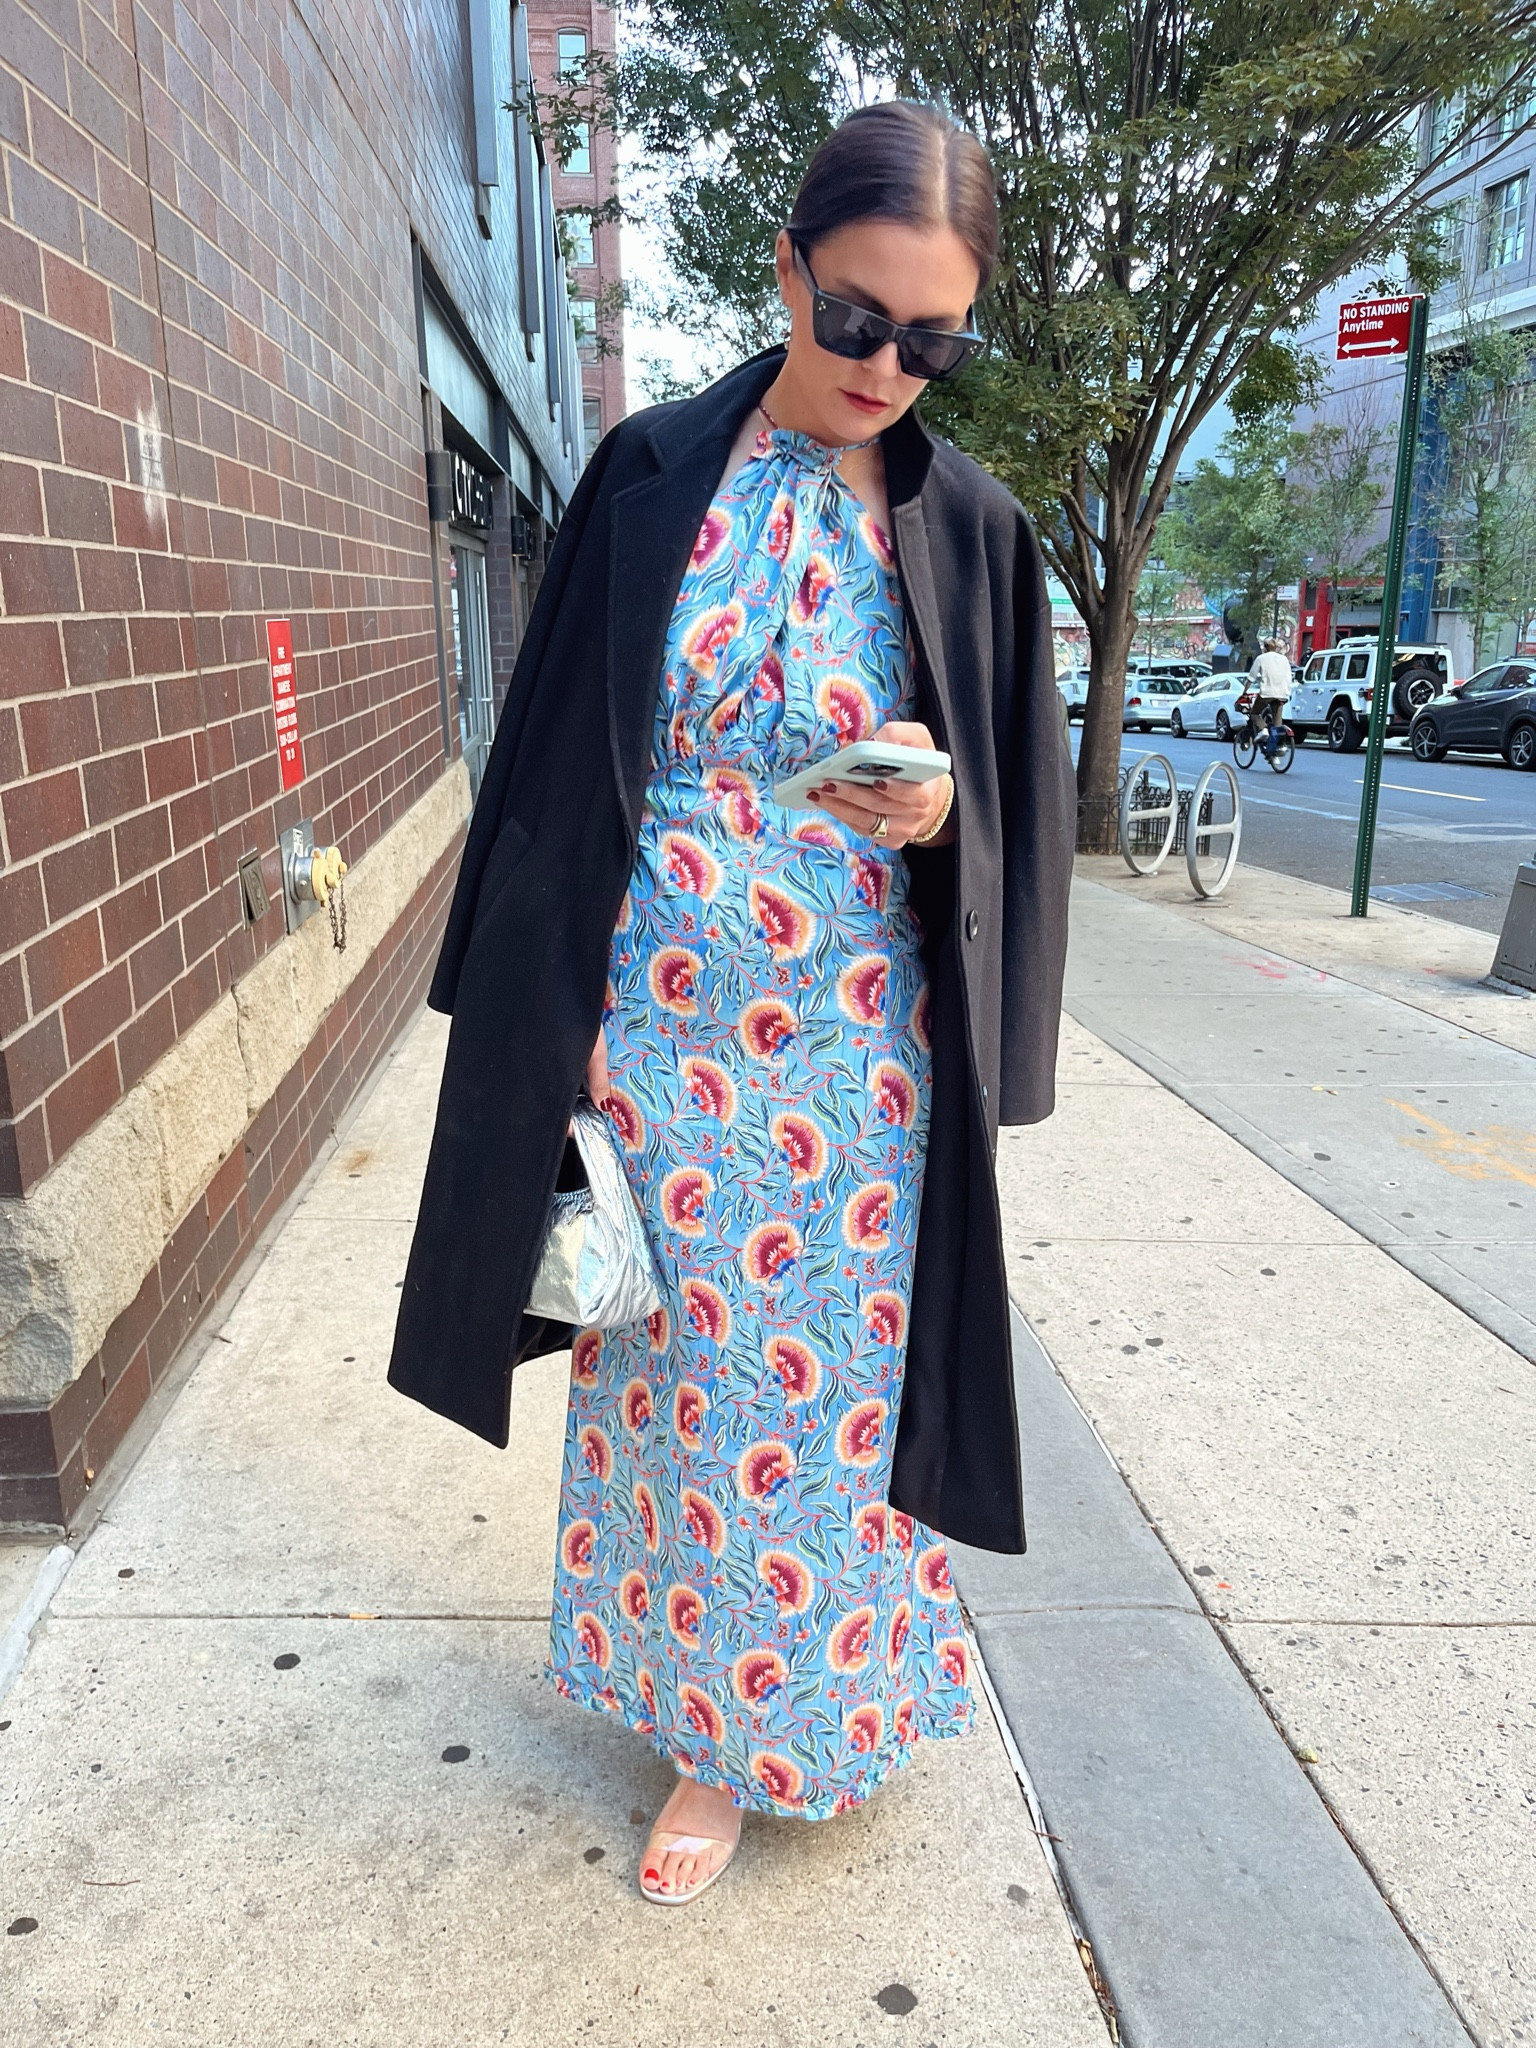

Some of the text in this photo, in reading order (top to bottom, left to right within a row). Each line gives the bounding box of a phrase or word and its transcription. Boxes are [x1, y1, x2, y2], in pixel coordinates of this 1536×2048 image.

[1343, 302, 1409, 319] NO STANDING
[1343, 320, 1384, 334] Anytime
